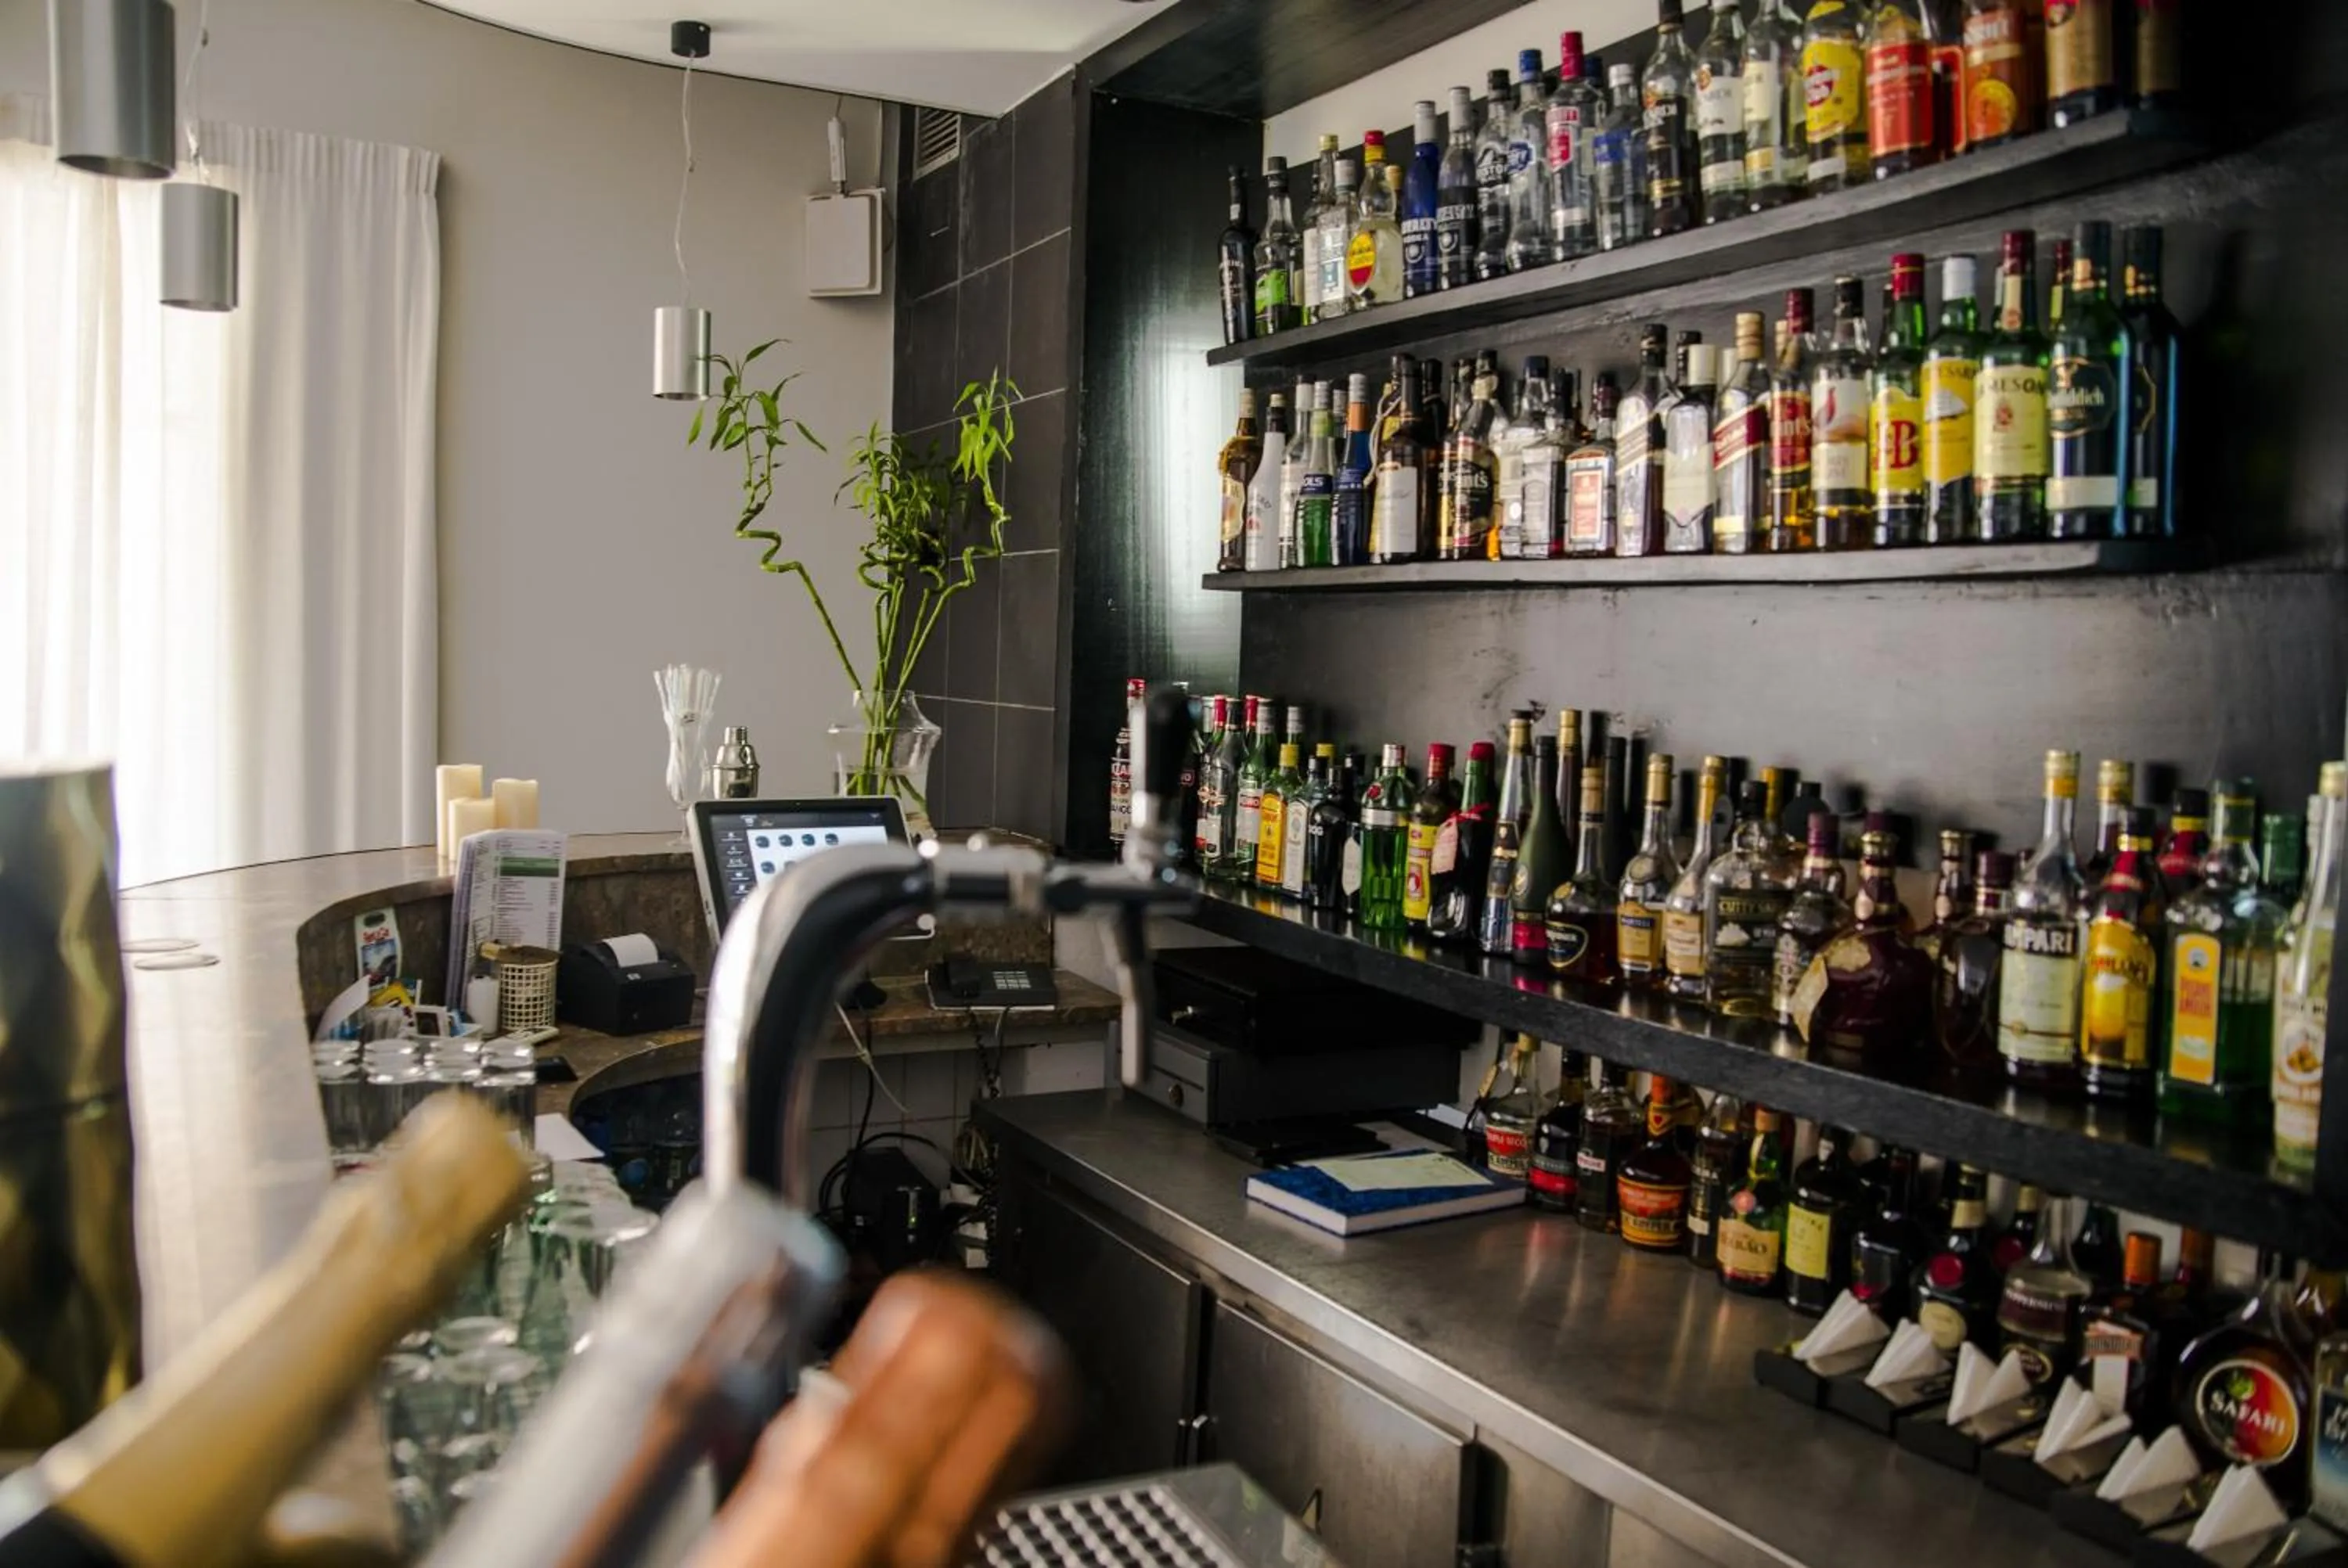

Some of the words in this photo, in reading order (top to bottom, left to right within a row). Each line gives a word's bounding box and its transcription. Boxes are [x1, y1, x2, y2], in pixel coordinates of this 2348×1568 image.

[1302, 476, 1323, 487] OLS
[2004, 923, 2073, 954] MPARI
[2210, 1389, 2286, 1438] SAFARI
